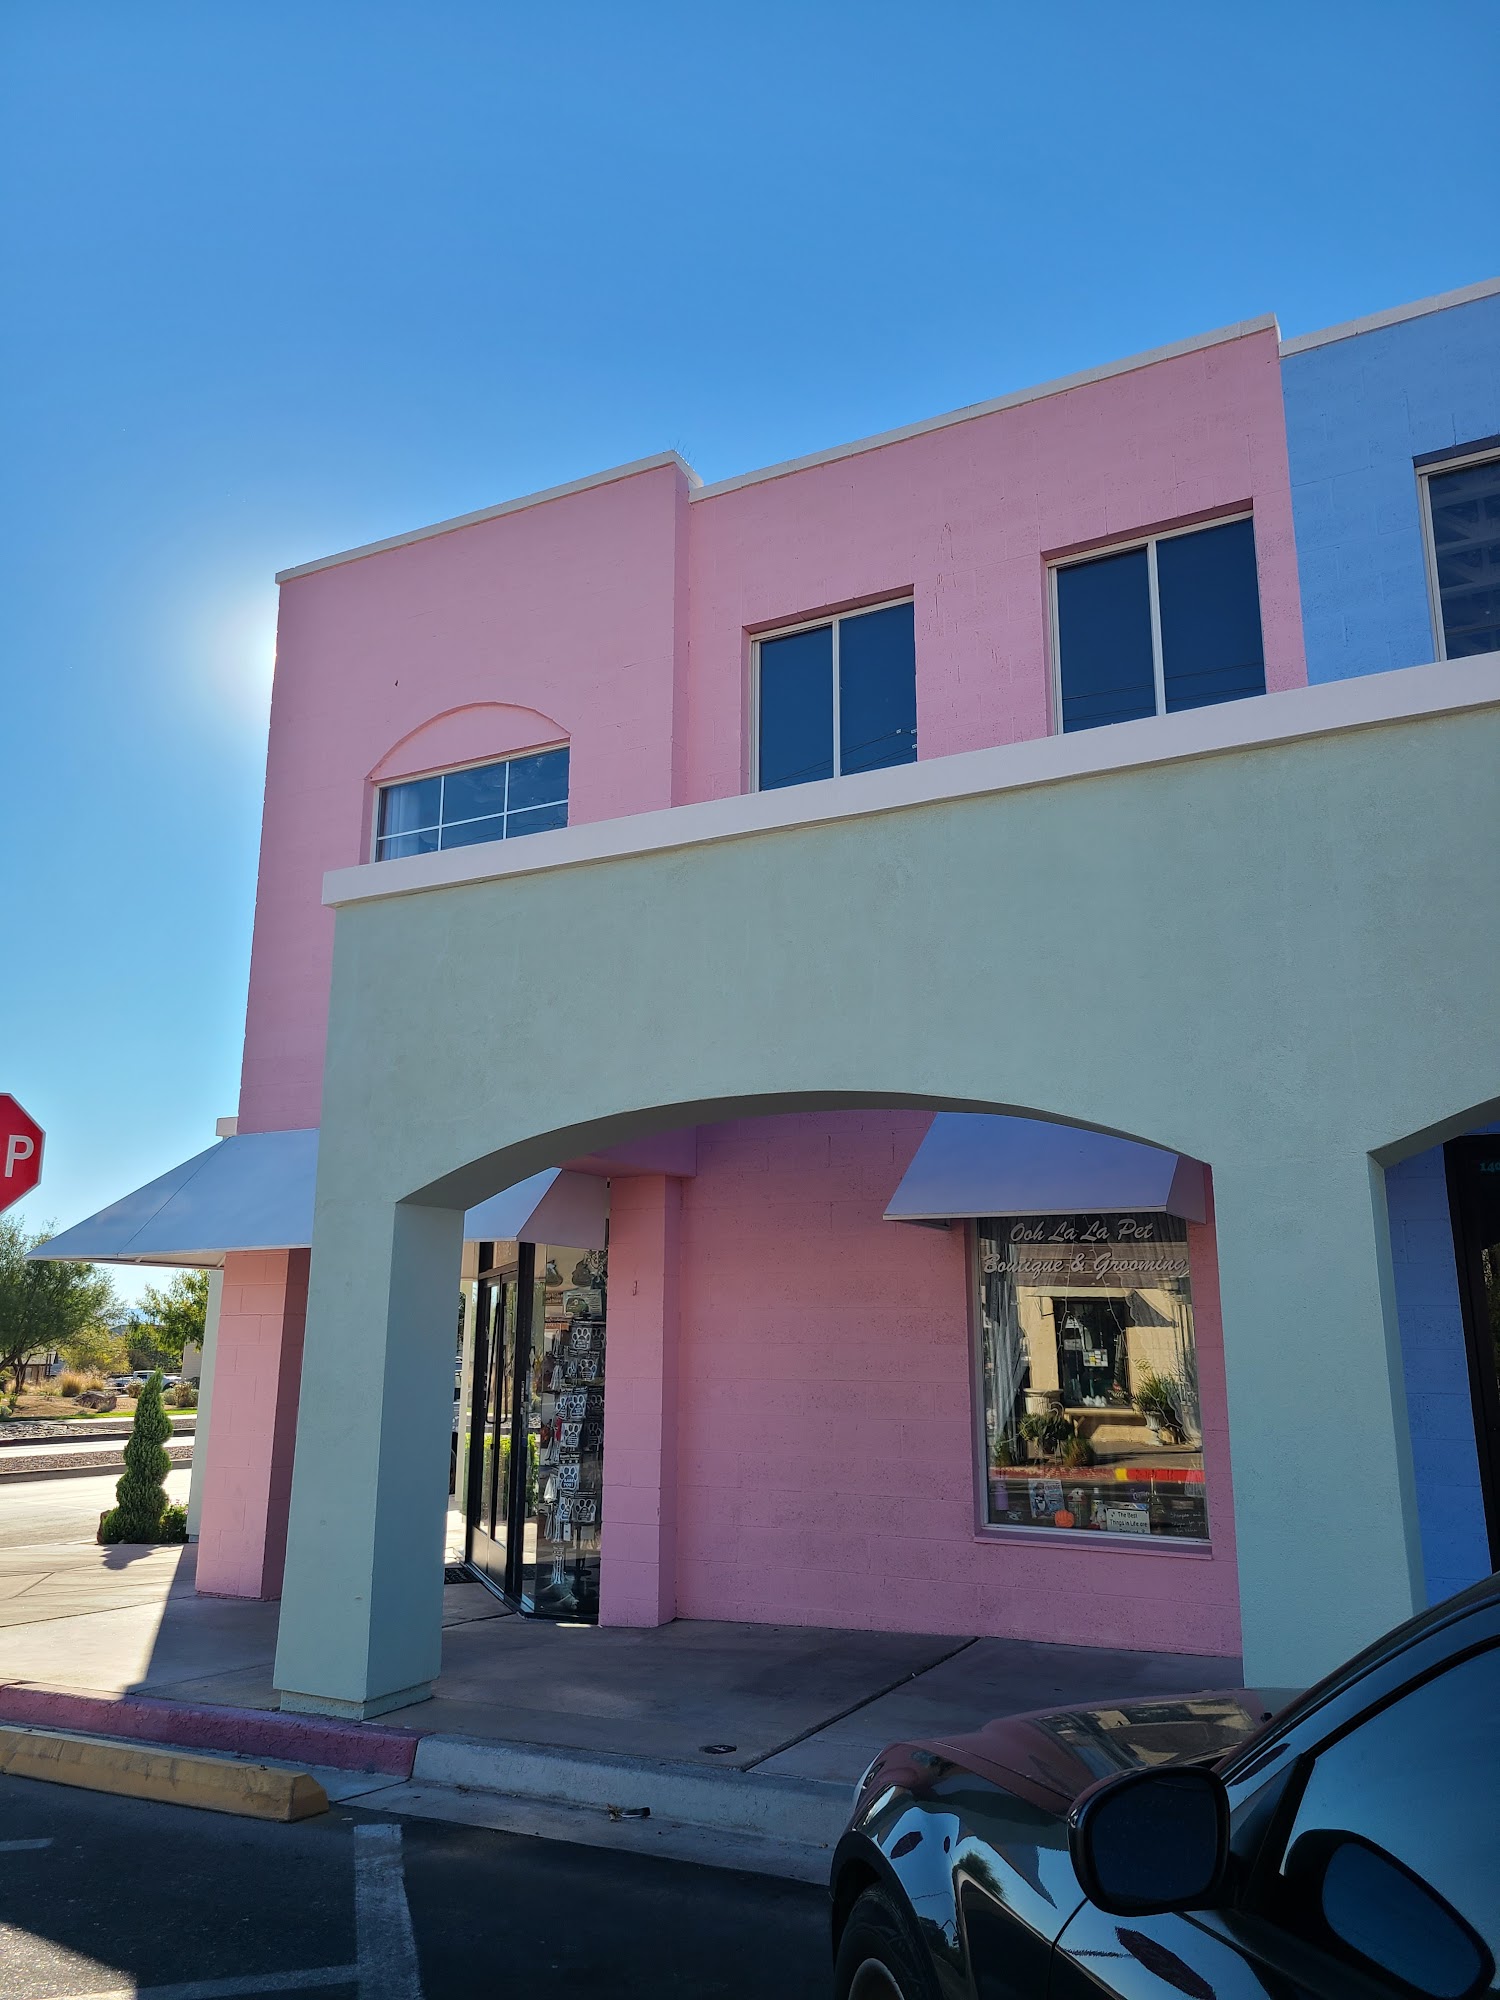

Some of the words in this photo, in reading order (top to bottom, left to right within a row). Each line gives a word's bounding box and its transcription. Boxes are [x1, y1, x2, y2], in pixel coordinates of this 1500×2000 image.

[1010, 1220, 1046, 1242] Ooh
[1047, 1221, 1077, 1242] La
[1080, 1220, 1110, 1242] La
[1117, 1218, 1154, 1241] Pet
[983, 1253, 1064, 1280] Boutique
[1070, 1252, 1087, 1273] &
[1093, 1251, 1190, 1280] Grooming
